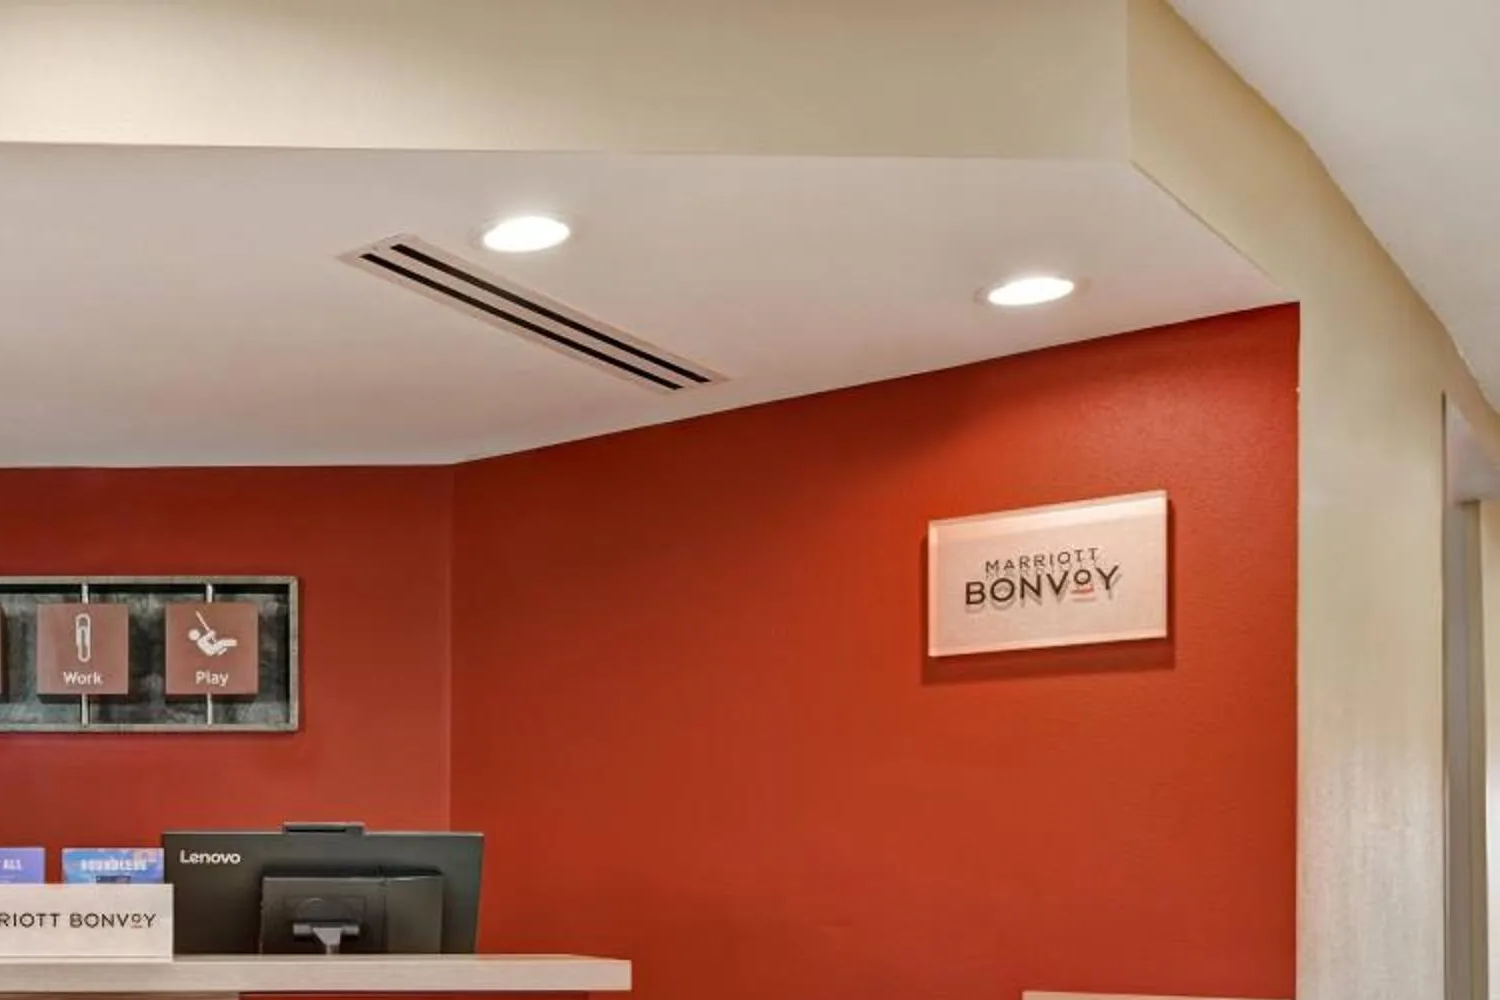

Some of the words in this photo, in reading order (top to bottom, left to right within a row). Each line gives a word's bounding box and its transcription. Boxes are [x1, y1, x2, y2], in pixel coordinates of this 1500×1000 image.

[985, 547, 1099, 573] MARRIOTT
[965, 565, 1119, 605] BONVOY
[63, 671, 103, 686] Work
[195, 671, 229, 687] Play
[179, 849, 241, 865] Lenovo
[69, 911, 157, 929] BONVOY
